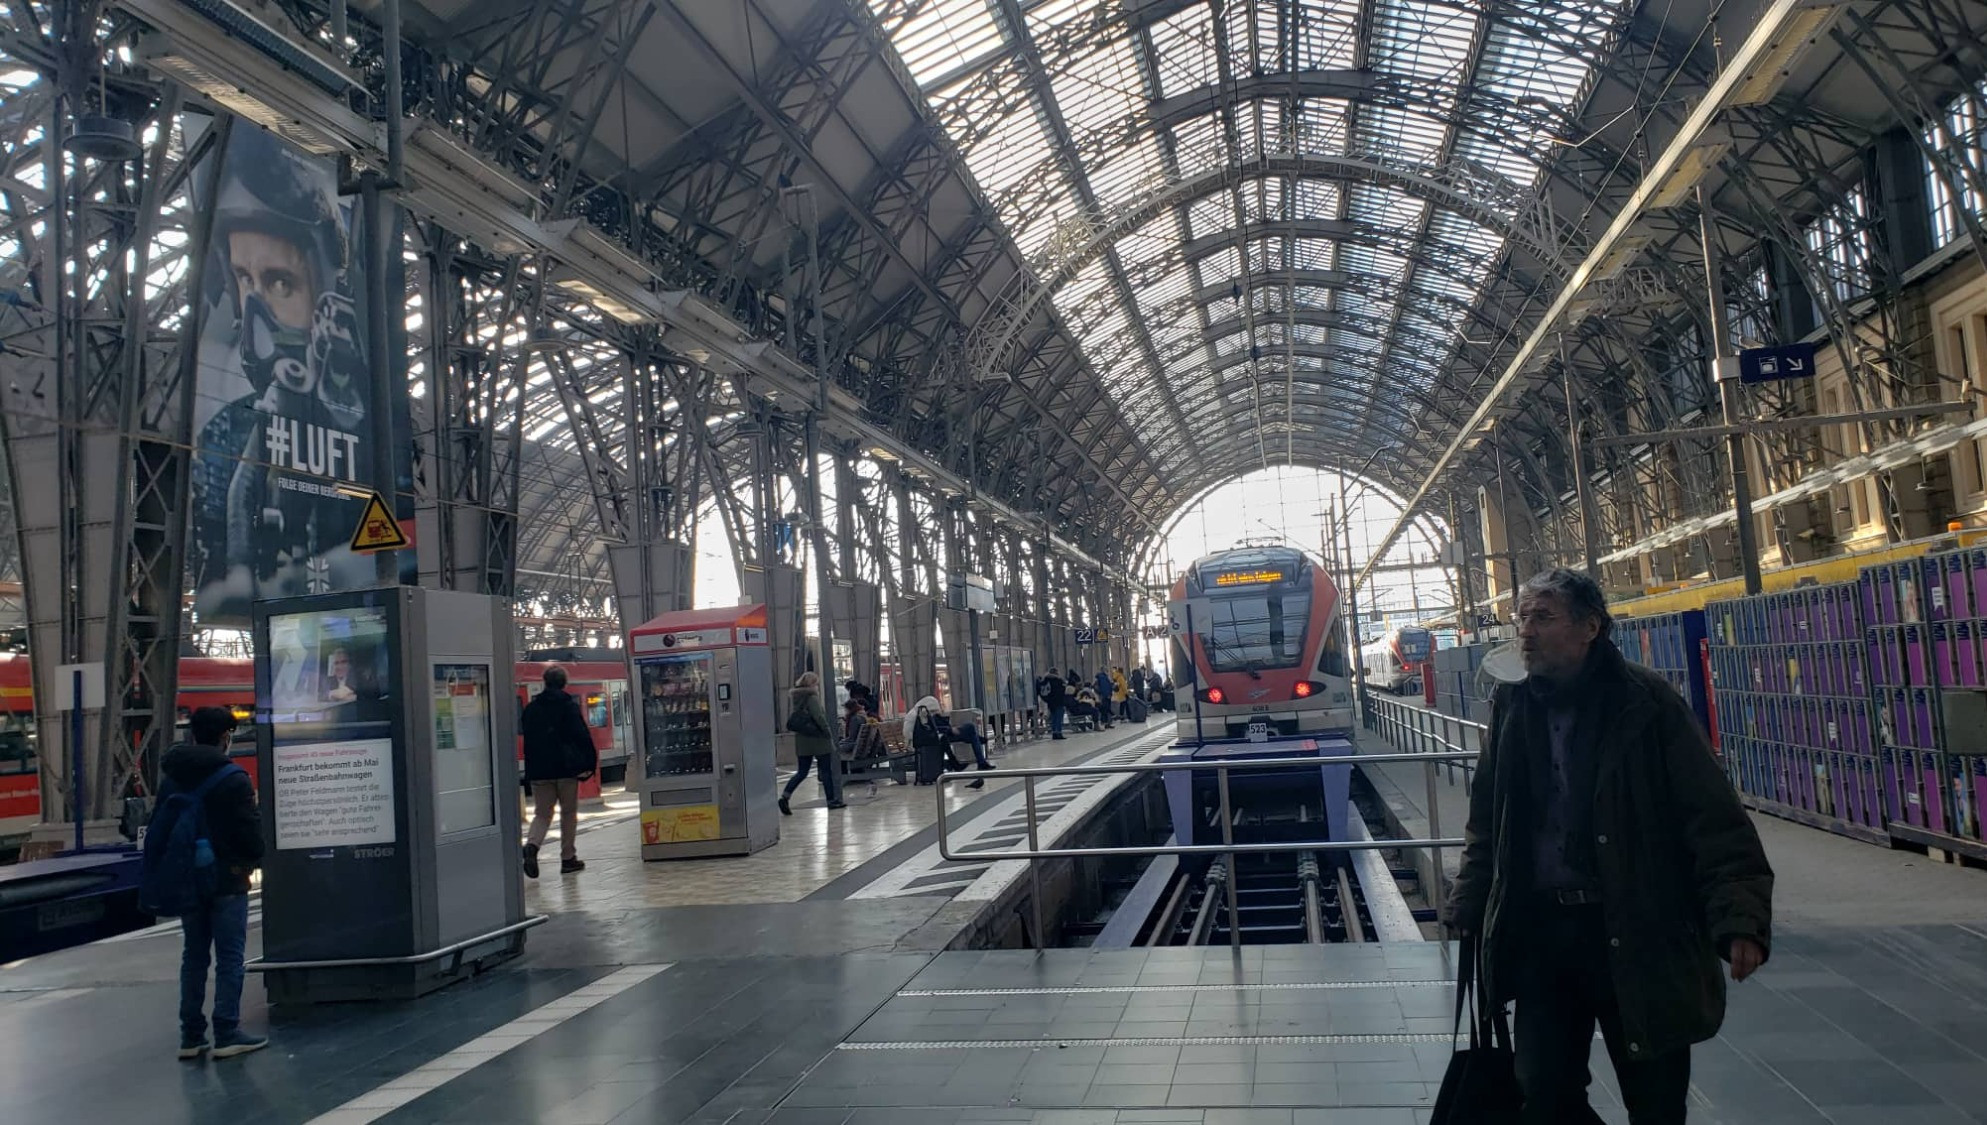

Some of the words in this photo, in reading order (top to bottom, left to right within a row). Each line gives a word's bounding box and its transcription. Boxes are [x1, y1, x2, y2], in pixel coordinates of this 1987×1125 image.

[266, 415, 359, 481] #LUFT
[278, 477, 298, 491] FOLGE
[298, 481, 319, 494] DEINER
[1482, 615, 1495, 624] 24
[1077, 630, 1091, 642] 22
[1146, 627, 1155, 637] A
[1250, 725, 1265, 734] 523
[278, 762, 313, 773] Frankfurt
[315, 760, 351, 771] bekommt
[353, 759, 362, 768] ab
[364, 758, 379, 767] Mai
[278, 776, 297, 785] neue
[299, 771, 373, 783] Straßenbahnwagen
[354, 847, 395, 859] STRÖER
